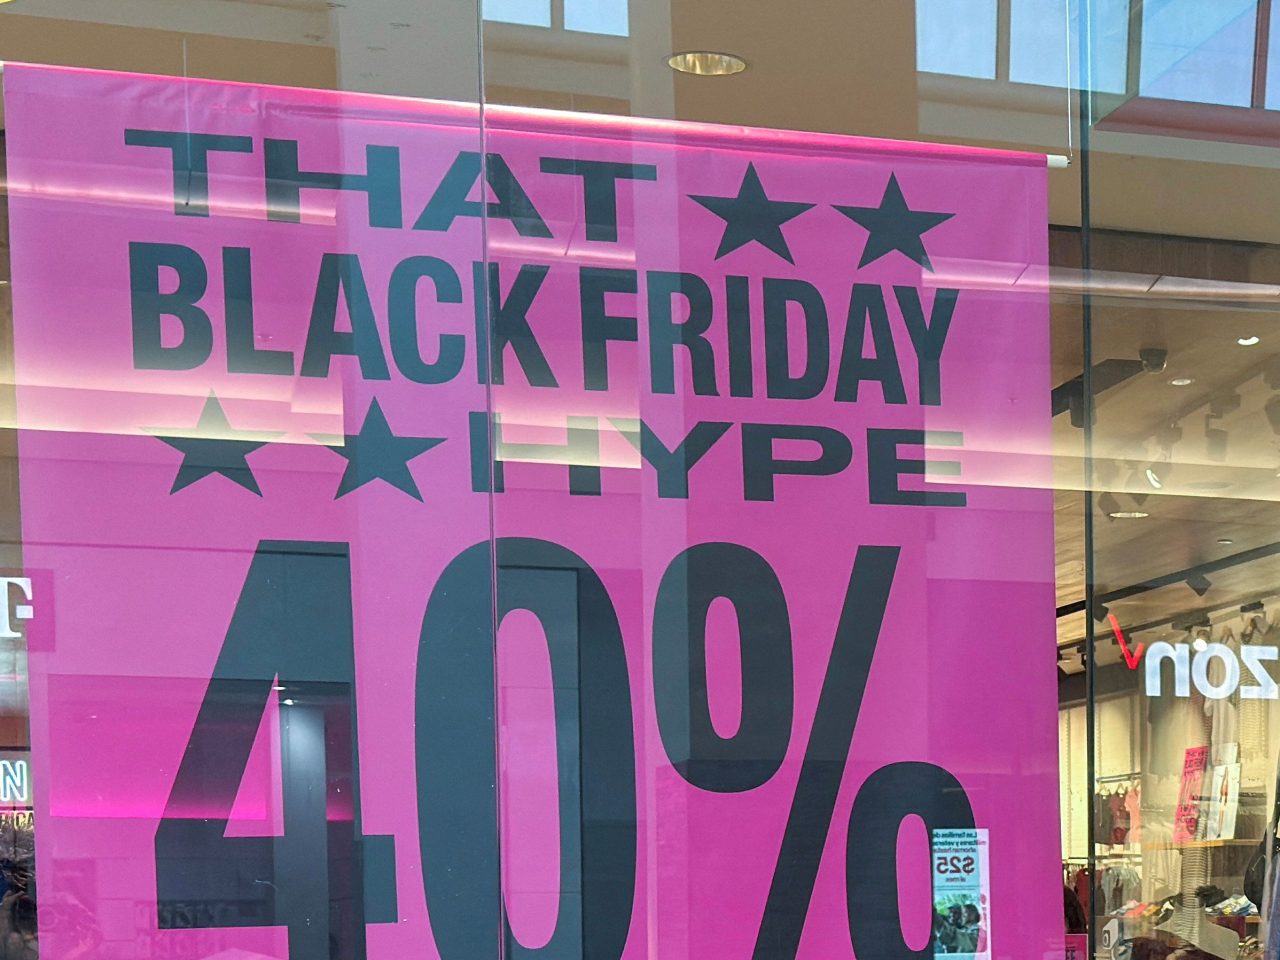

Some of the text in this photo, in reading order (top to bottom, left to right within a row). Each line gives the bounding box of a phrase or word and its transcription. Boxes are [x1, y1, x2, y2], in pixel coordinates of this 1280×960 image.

[124, 128, 656, 242] THAT
[128, 241, 960, 407] BLACK FRIDAY
[469, 410, 967, 507] HYPE
